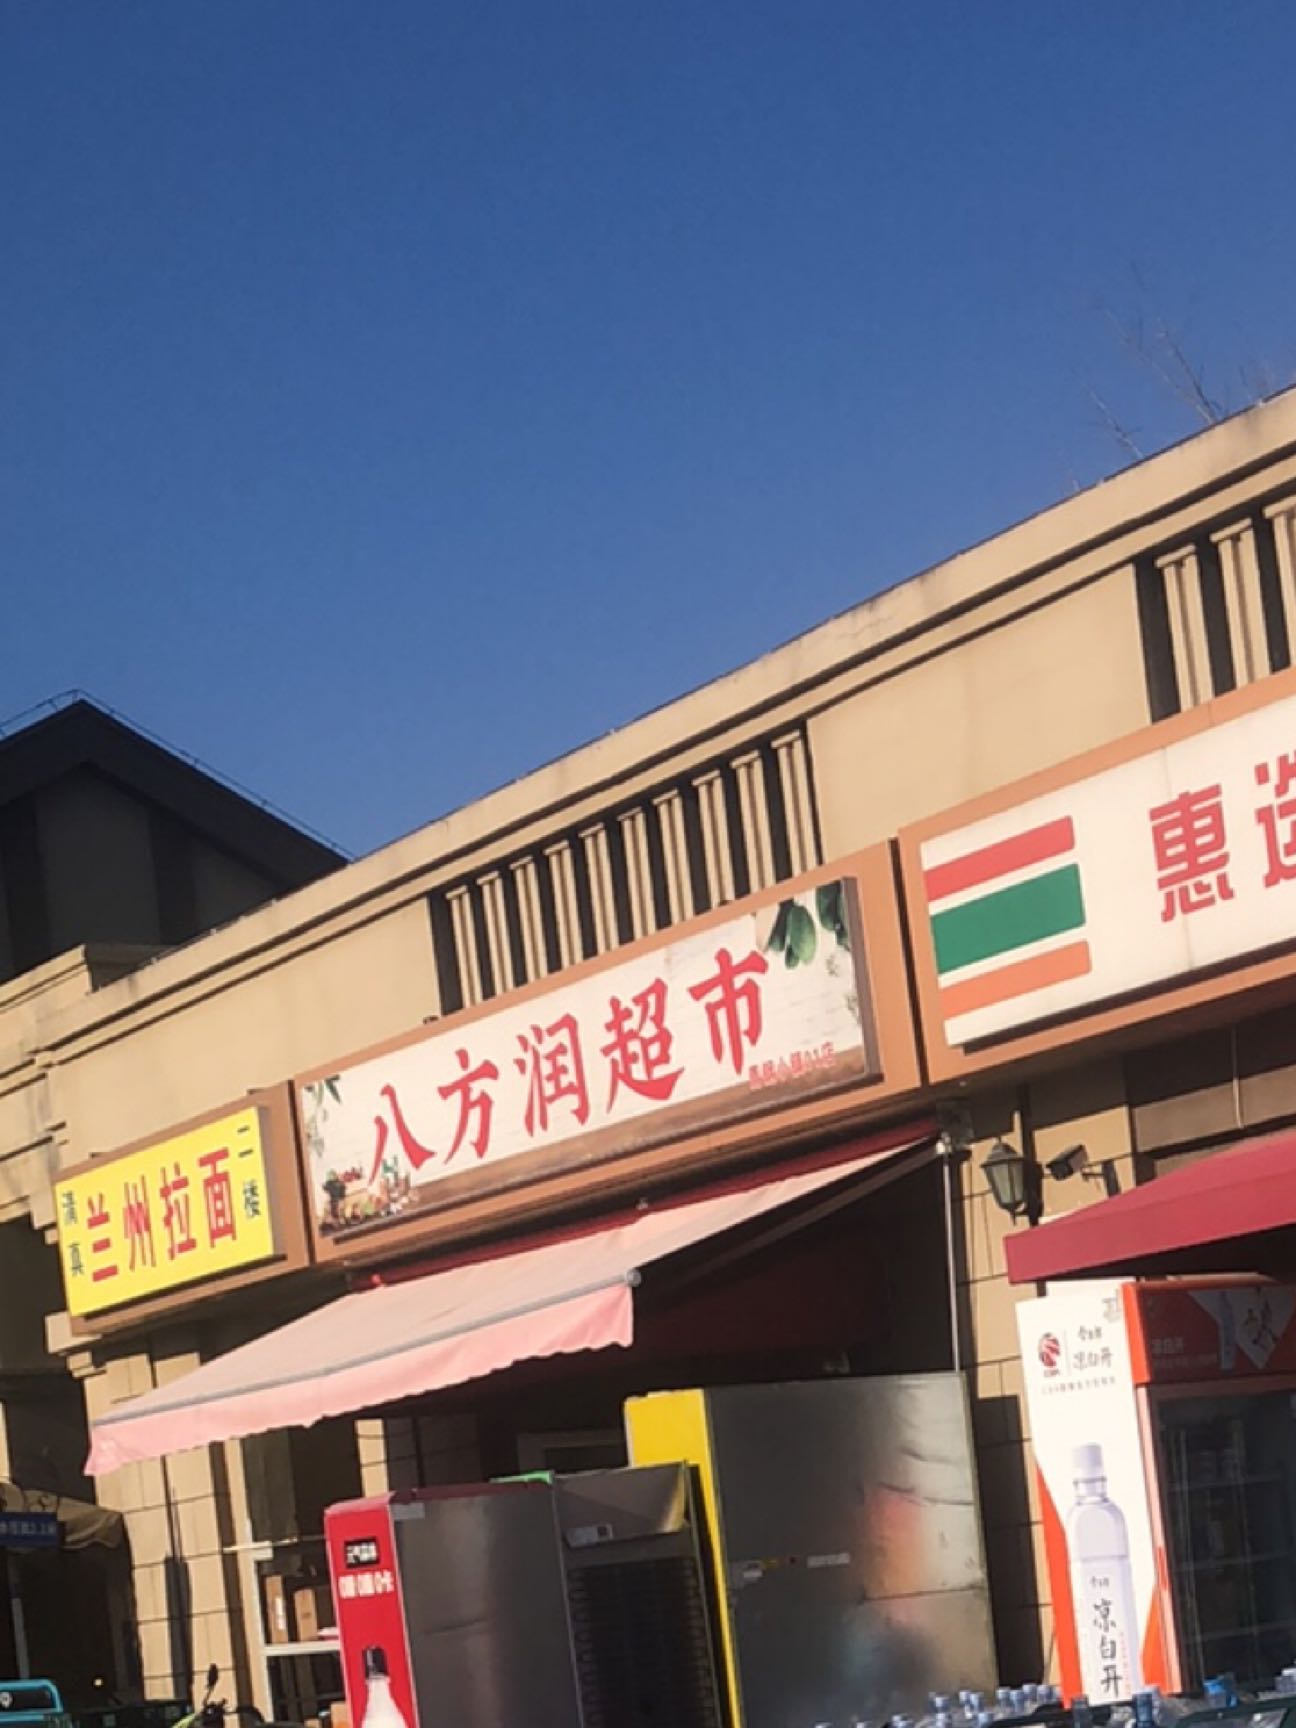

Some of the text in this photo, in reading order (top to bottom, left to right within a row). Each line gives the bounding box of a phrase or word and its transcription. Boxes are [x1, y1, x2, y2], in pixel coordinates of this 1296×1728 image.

[368, 947, 768, 1181] 八方润超市
[86, 1146, 237, 1283] 兰州拉面
[1092, 1599, 1123, 1698] 凉白开
